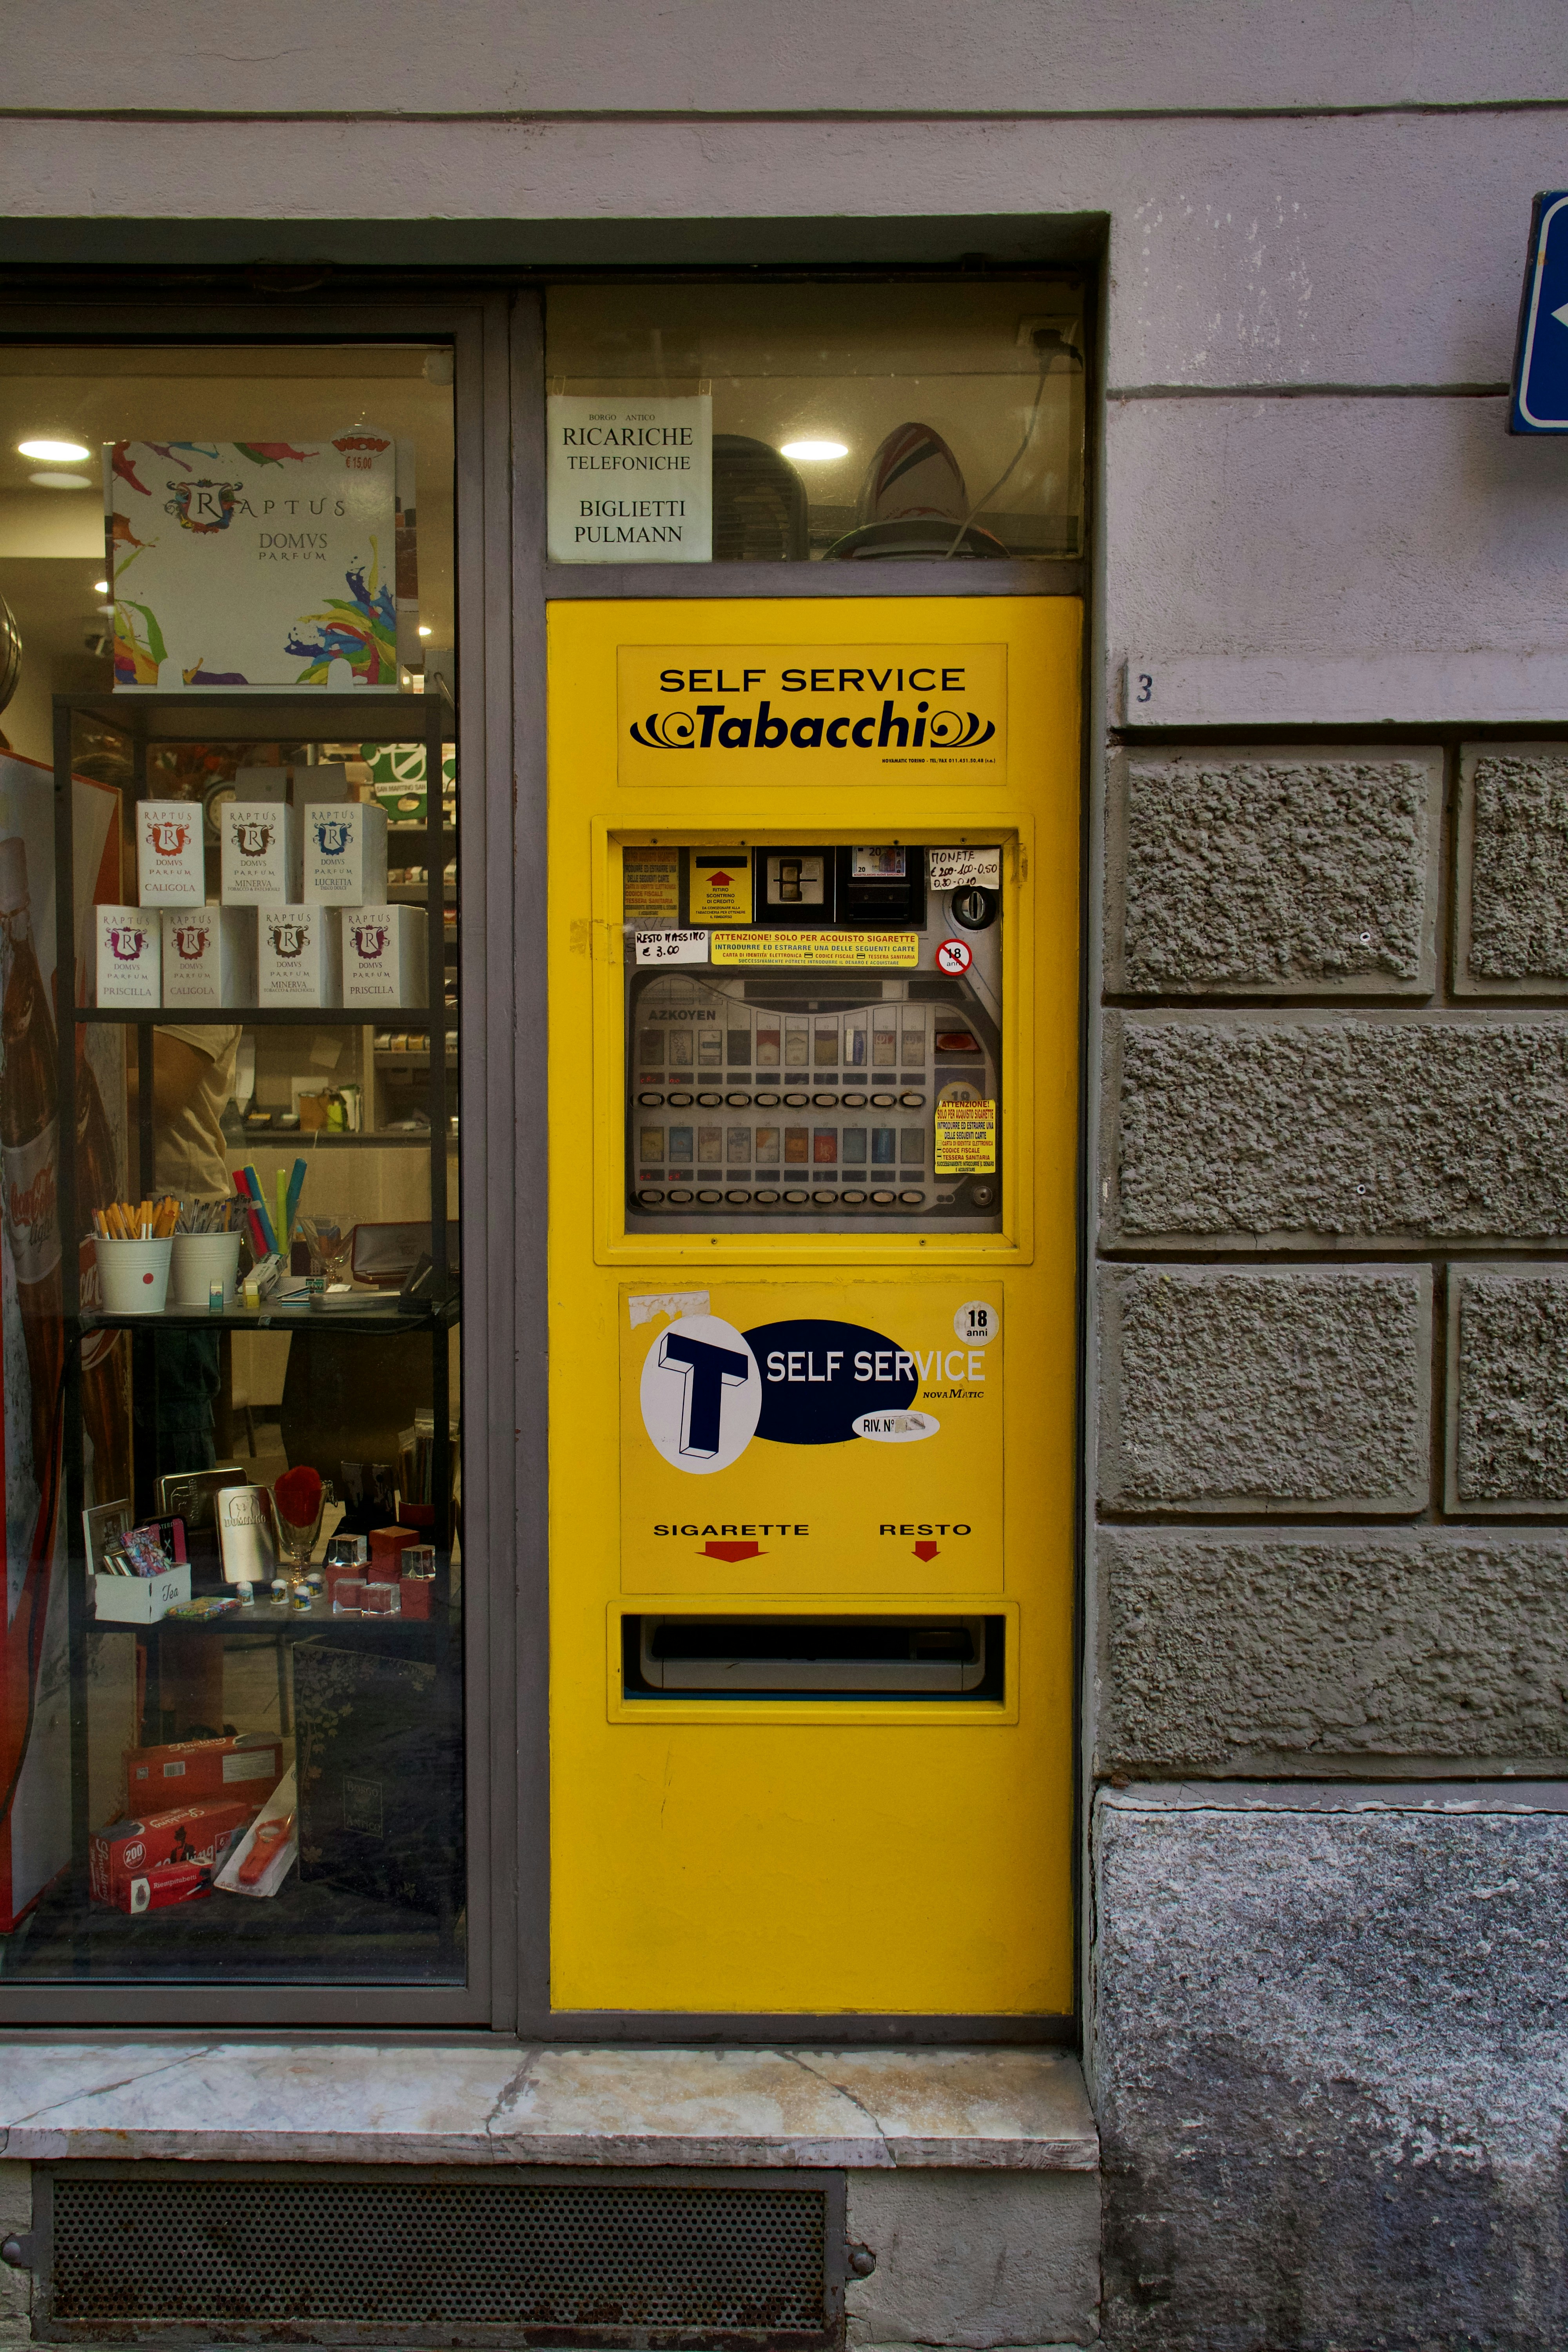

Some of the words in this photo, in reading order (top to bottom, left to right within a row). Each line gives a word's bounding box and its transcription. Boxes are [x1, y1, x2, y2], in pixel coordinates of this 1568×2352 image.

[562, 428, 693, 446] RICARICHE
[332, 437, 390, 452] WOW
[346, 456, 351, 469] €
[353, 456, 372, 469] 15,00
[567, 456, 691, 470] TELEFONICHE
[579, 500, 686, 517] BIGLIETTI
[259, 533, 328, 549] DOMVS
[574, 526, 683, 543] PULMANN
[259, 552, 326, 561] PARFUM
[660, 668, 766, 692] SELF
[781, 668, 965, 692] SERVICE
[1137, 674, 1152, 702] 3
[696, 701, 929, 748] Tabacchi
[145, 812, 191, 820] RAPTUS
[230, 812, 276, 821] RAPTUS
[312, 811, 354, 820] RAPTUS
[869, 848, 881, 856] 20
[931, 851, 975, 864] MONETE
[104, 916, 149, 925] RAPTUS
[170, 915, 211, 925] RAPTUS
[267, 913, 311, 922] RAPTUS
[348, 914, 390, 924] RAPTUS
[637, 933, 662, 943] RESTO
[665, 932, 705, 942] MASSIMO
[643, 947, 650, 956] €
[657, 946, 679, 957] 3.00
[947, 948, 961, 958] 18
[648, 1010, 716, 1020] AZKOYEN
[937, 1110, 947, 1119] SOLO
[956, 1110, 974, 1119] ACQUISTO
[975, 1110, 994, 1119] SIGARETTE
[967, 1310, 987, 1328] 18
[967, 1328, 987, 1337] anni
[767, 1351, 844, 1382] SELF
[853, 1351, 985, 1382] SERVICE
[659, 1332, 748, 1459] T
[864, 1419, 880, 1432] RIV.
[653, 1524, 809, 1536] SIGARETTE
[880, 1524, 971, 1535] RESTO
[162, 1584, 179, 1601] Tea
[168, 1737, 226, 1752] Smoking
[125, 1844, 142, 1862] 200
[153, 1875, 197, 1889] Riempitubetti
